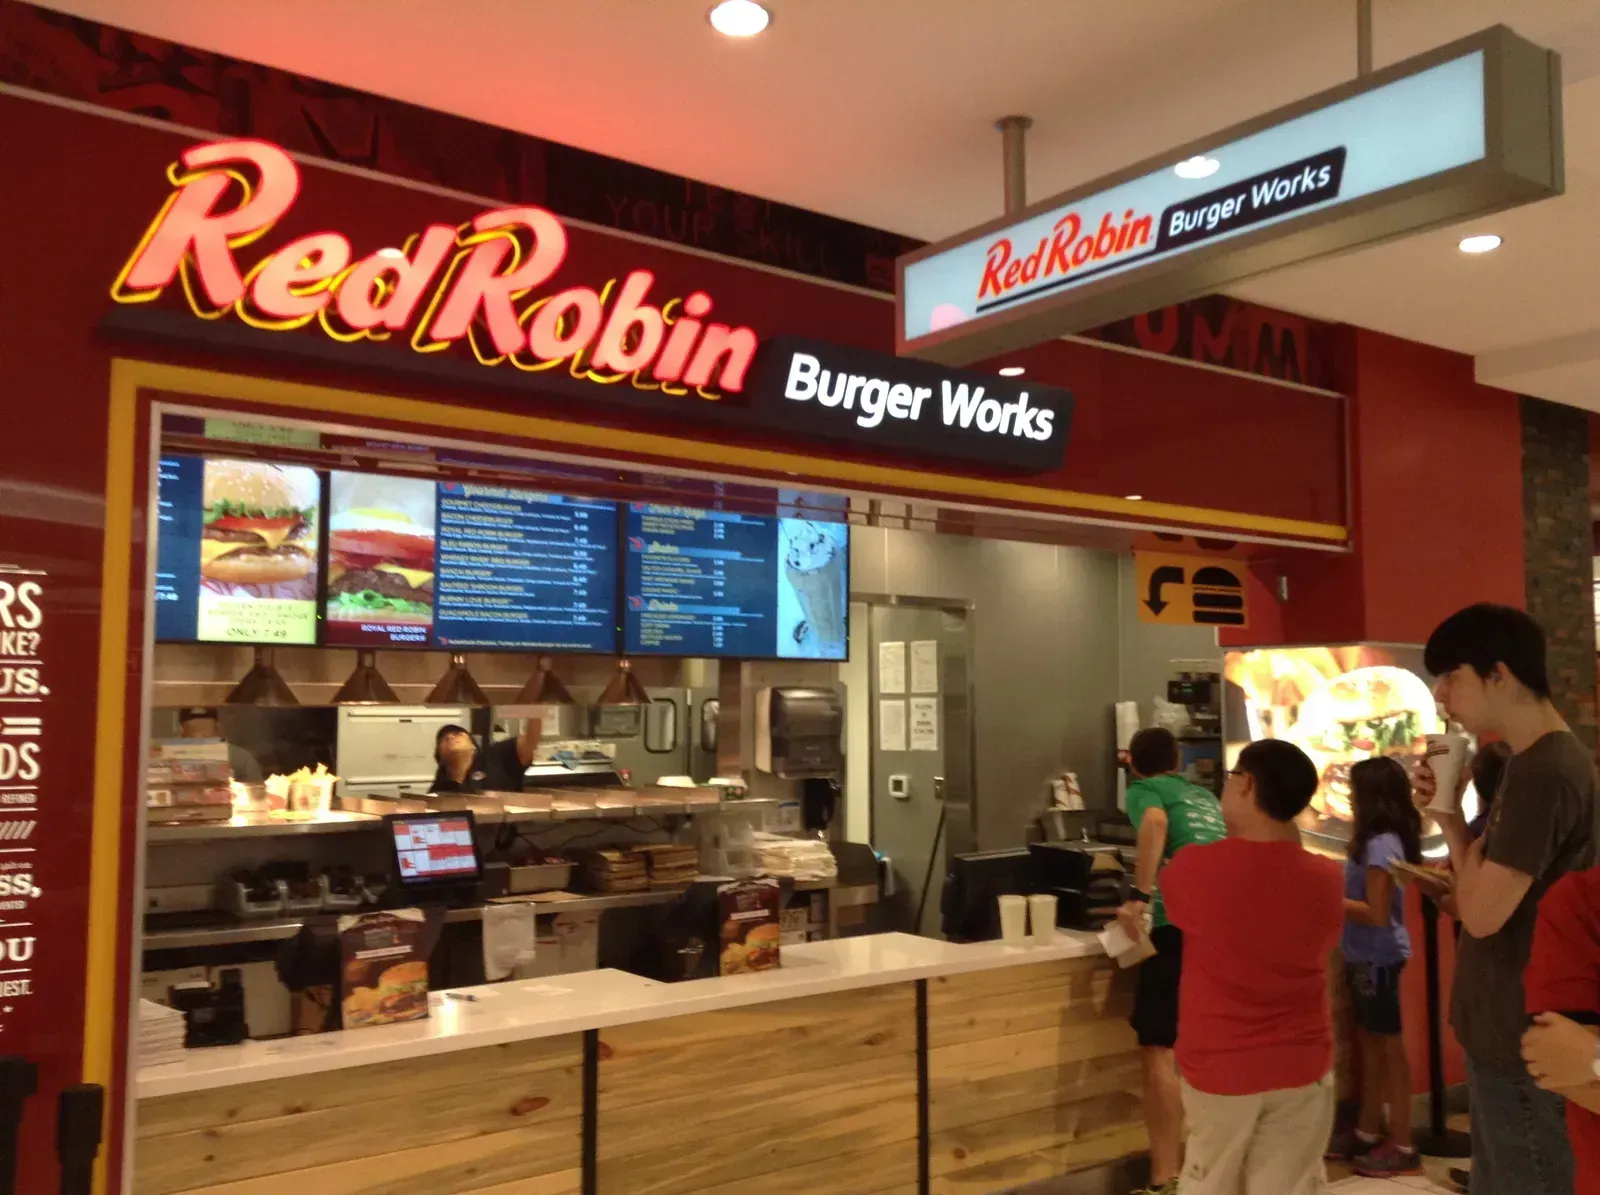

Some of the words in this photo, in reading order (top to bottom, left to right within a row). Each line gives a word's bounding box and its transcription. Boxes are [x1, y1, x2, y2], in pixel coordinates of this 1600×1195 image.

[1168, 190, 1246, 237] Burger
[1251, 163, 1332, 210] Works
[785, 351, 932, 428] Burger
[941, 380, 1055, 441] Works
